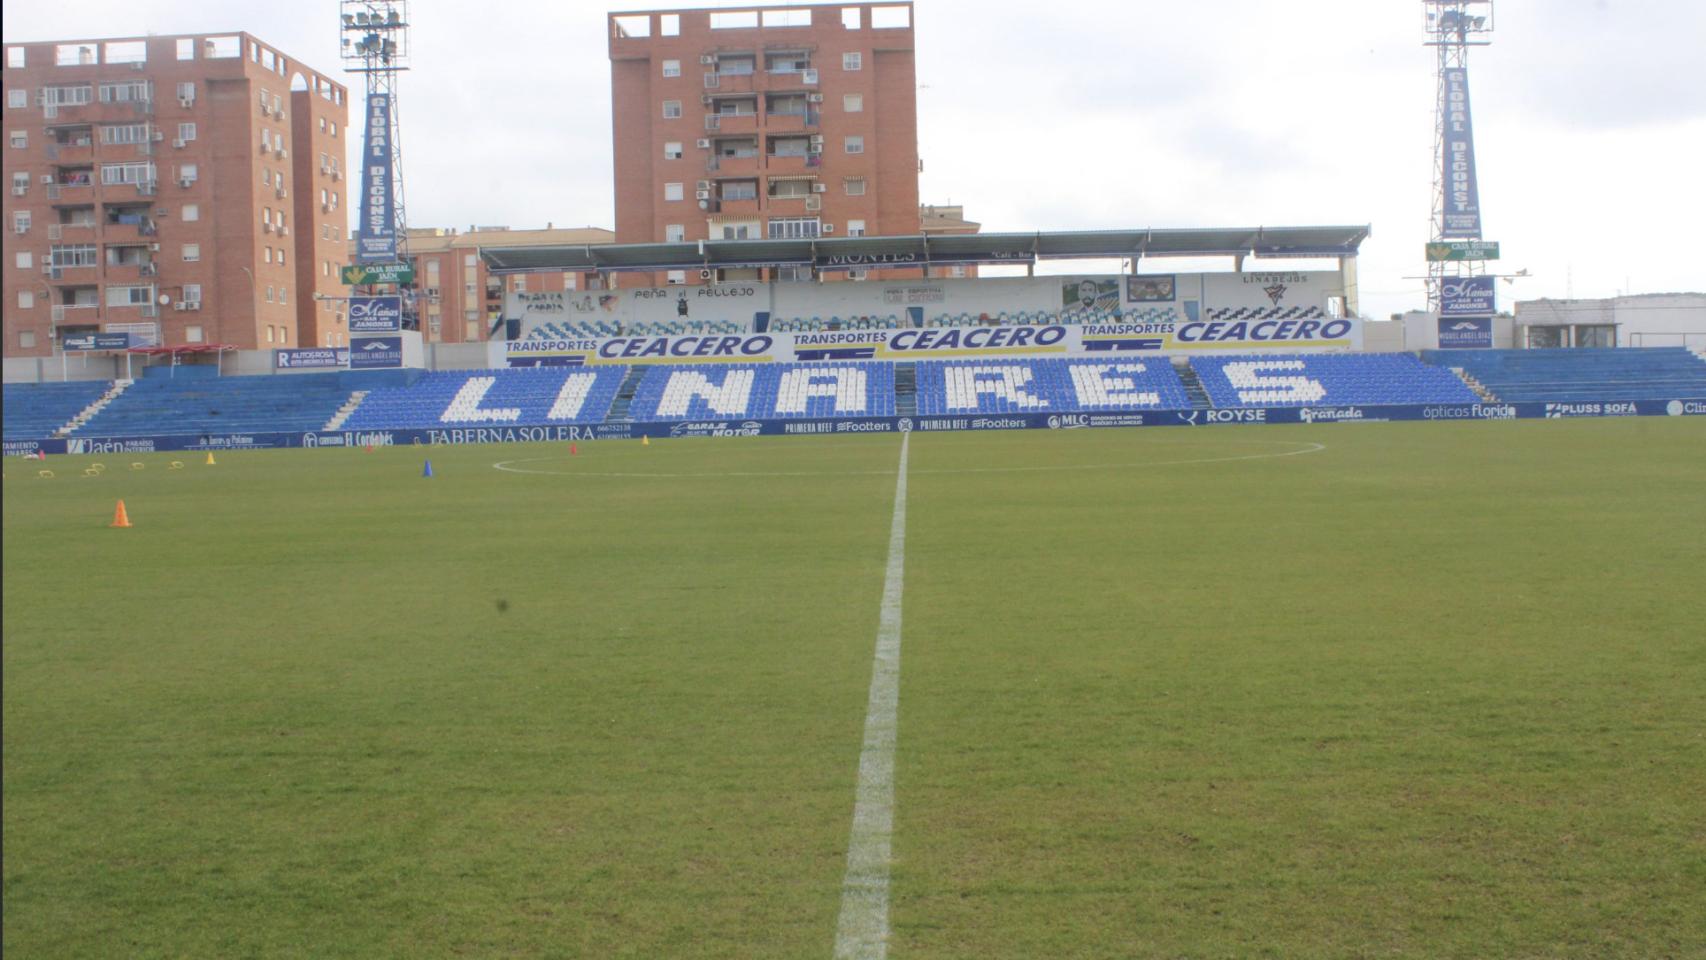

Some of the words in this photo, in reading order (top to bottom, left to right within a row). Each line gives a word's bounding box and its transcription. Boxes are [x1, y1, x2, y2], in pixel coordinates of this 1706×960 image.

[1449, 72, 1464, 132] GLOBAL
[370, 97, 386, 157] GLOBAL
[385, 264, 411, 273] RURAL
[1082, 323, 1175, 336] TRANSPORTES
[1177, 319, 1353, 342] CEACERO
[793, 331, 887, 345] TRANSPORTES
[890, 326, 1067, 350] CEACERO
[506, 340, 597, 352] TRANSPORTES
[599, 336, 774, 358] CEACERO
[440, 360, 1327, 422] LINARES
[1206, 409, 1266, 421] ROYSE
[1299, 406, 1363, 423] Granada
[1472, 404, 1516, 417] florida
[1561, 403, 1600, 414] PLUSS
[687, 422, 728, 430] GARAJE
[920, 419, 951, 430] PRIMERA
[981, 418, 1027, 428] Footters
[1061, 414, 1088, 425] MLC
[712, 428, 760, 437] MOTOR
[785, 423, 816, 433] PRIMERA
[846, 421, 891, 431] Footters
[427, 428, 517, 444] TABERNA
[519, 425, 595, 442] SOLERA
[83, 438, 124, 454] Jaén
